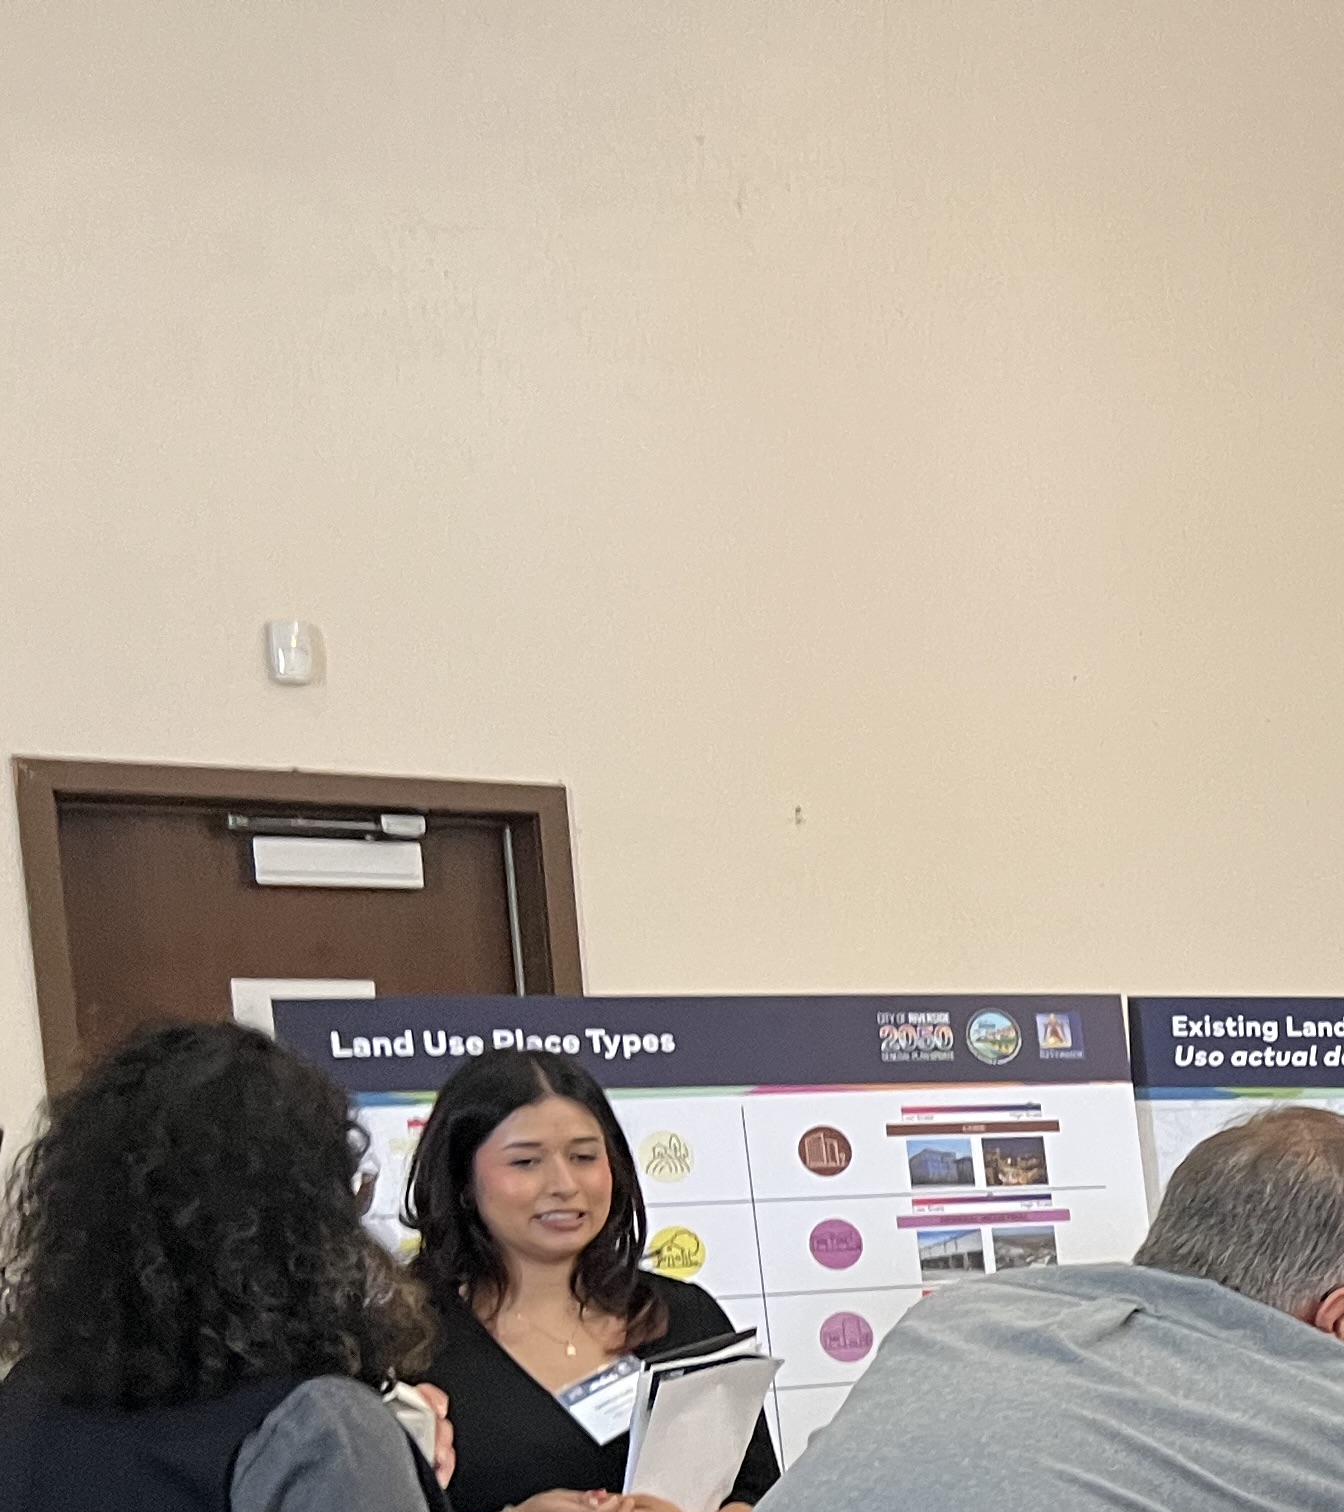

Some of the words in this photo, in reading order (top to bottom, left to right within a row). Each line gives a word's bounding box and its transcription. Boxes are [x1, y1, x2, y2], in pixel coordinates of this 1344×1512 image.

[880, 1024, 953, 1050] 2050
[1172, 1015, 1278, 1043] Existing
[331, 1030, 413, 1058] Land
[423, 1030, 484, 1056] Use
[493, 1029, 580, 1054] Place
[585, 1028, 675, 1059] Types
[1175, 1045, 1224, 1067] Uso
[1231, 1045, 1317, 1067] actual
